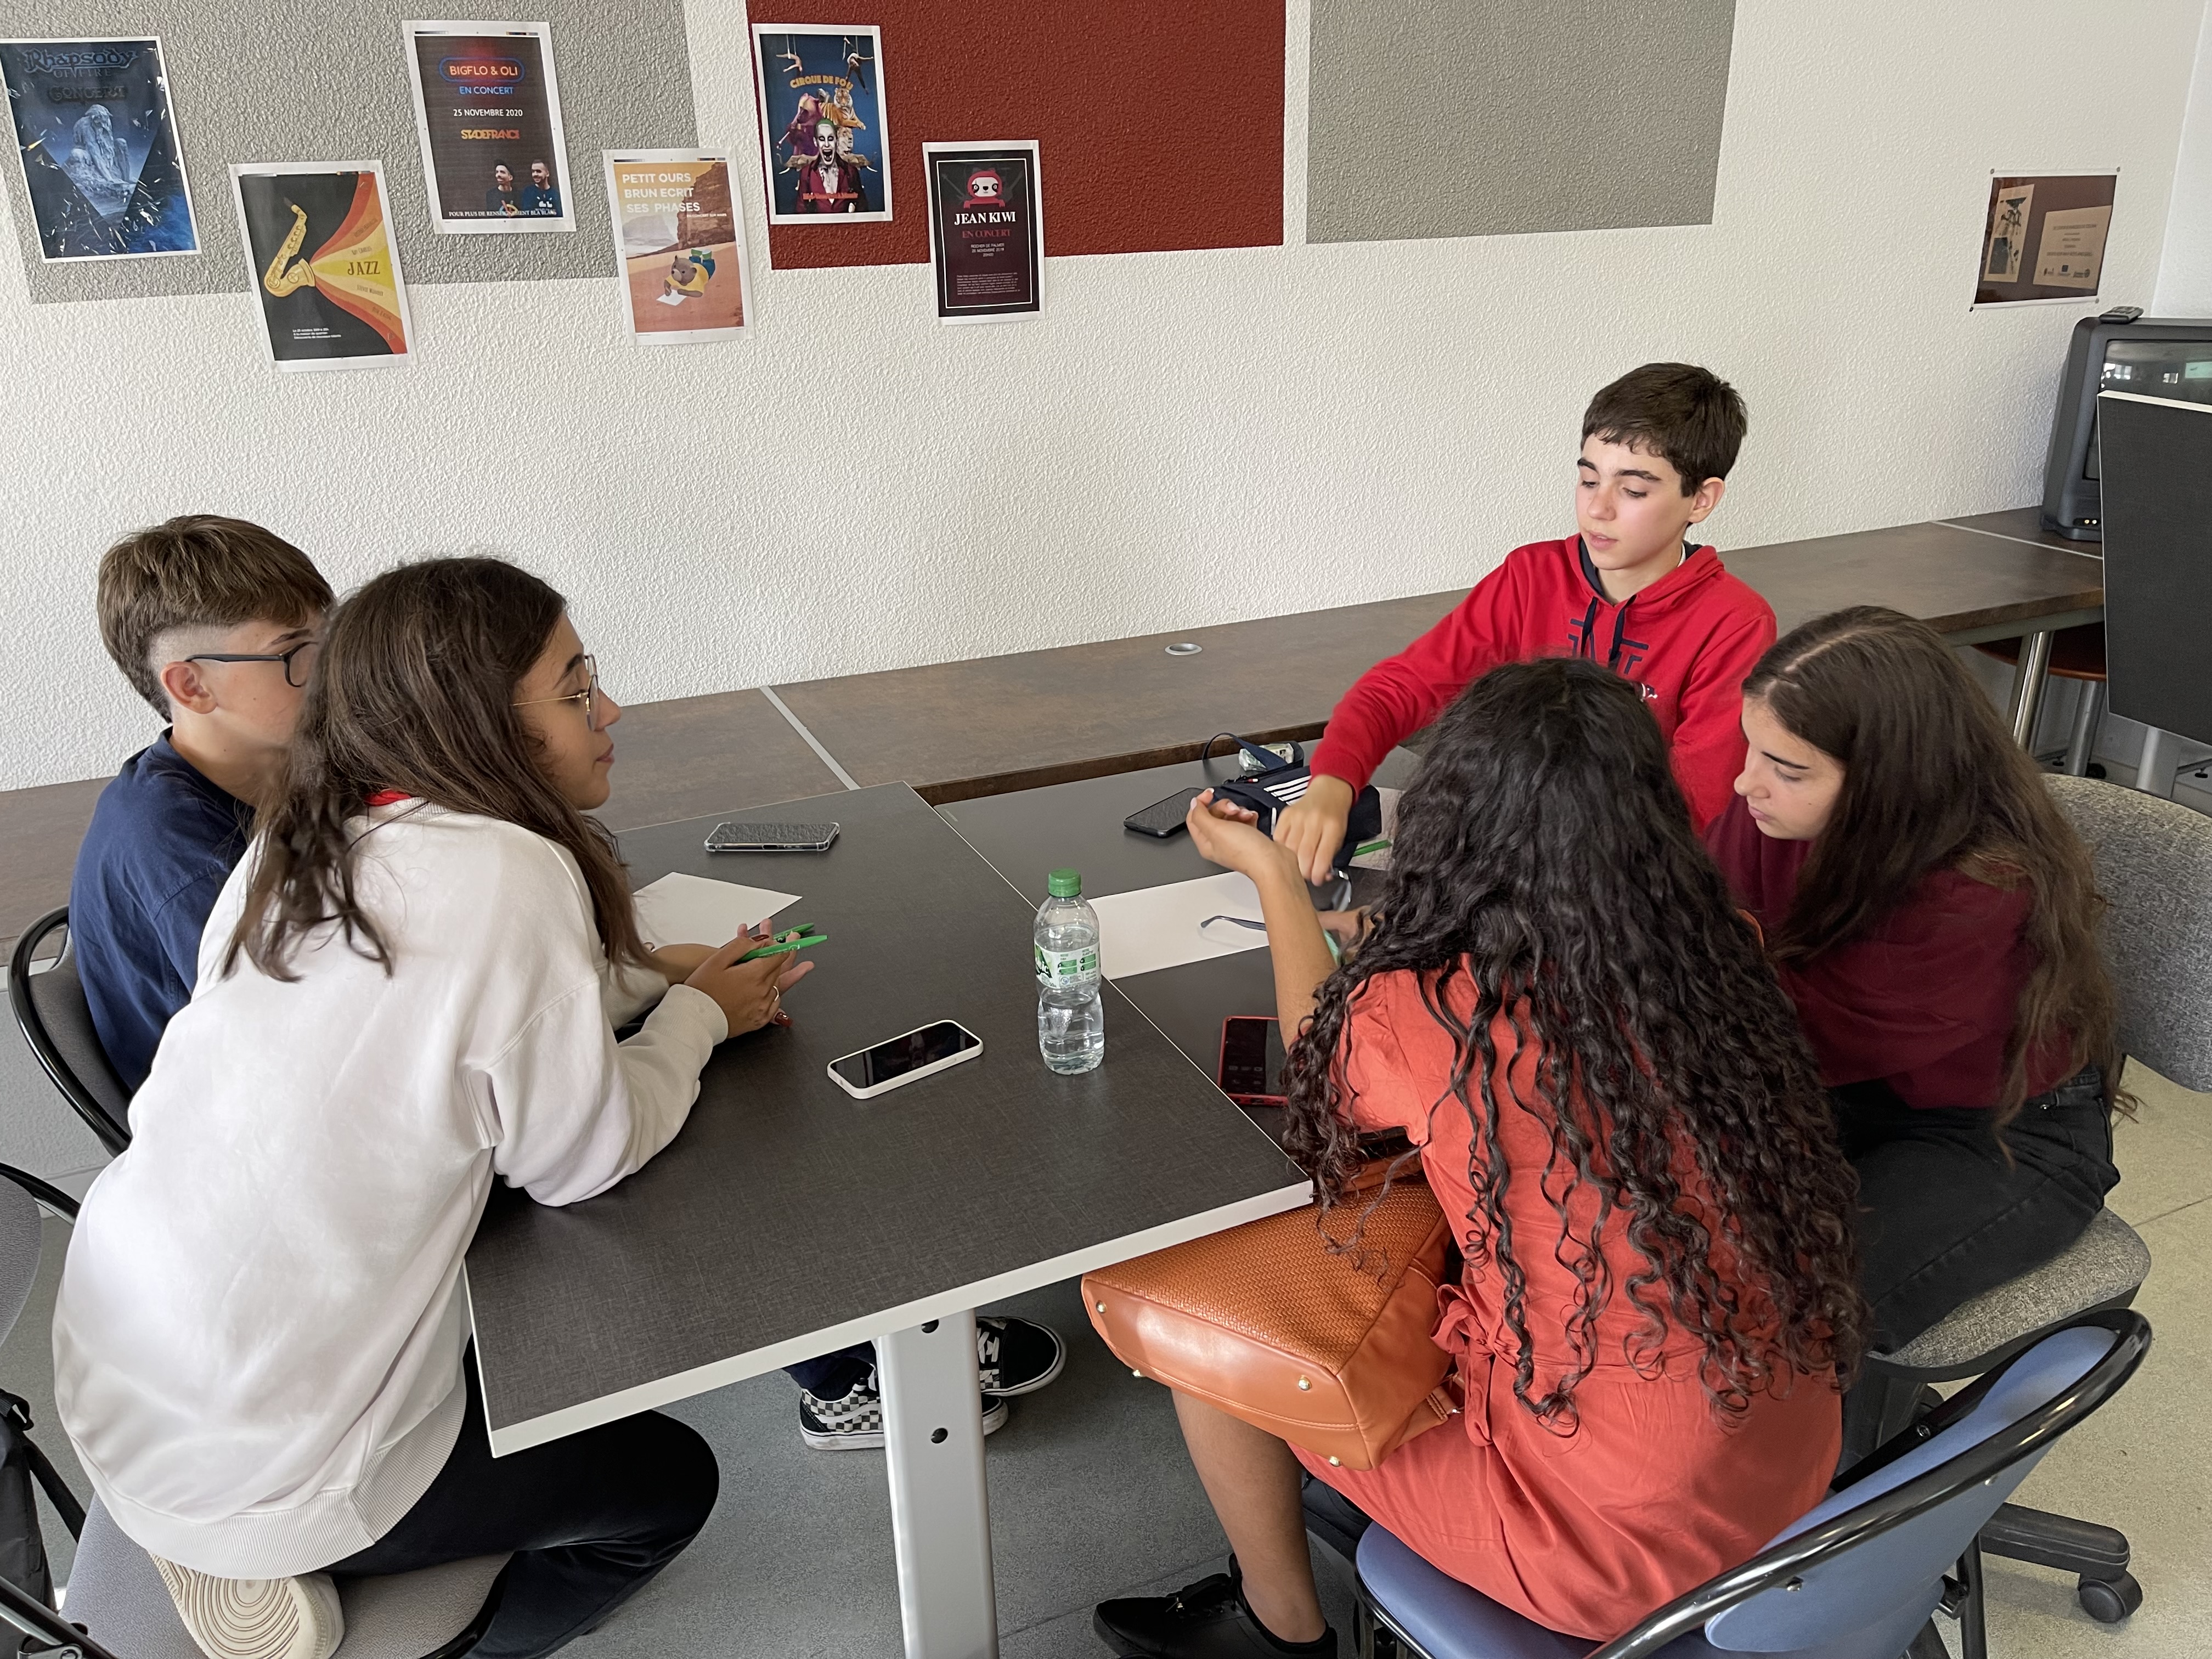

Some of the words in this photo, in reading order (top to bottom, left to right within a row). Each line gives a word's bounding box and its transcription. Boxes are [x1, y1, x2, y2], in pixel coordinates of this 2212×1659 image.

[449, 66, 488, 75] BIGFLO
[490, 66, 498, 75] &
[500, 66, 518, 76] OLI
[790, 75, 822, 88] CIRQUE
[822, 75, 833, 84] DE
[459, 86, 472, 94] EN
[473, 86, 514, 94] CONCERT
[622, 173, 656, 184] PETIT
[659, 173, 691, 183] OURS
[624, 189, 657, 199] BRUN
[661, 188, 694, 198] ECRIT
[627, 204, 649, 213] SES
[654, 202, 701, 213] PHASES
[954, 213, 986, 225] JEAN
[989, 211, 1016, 223] KIWI
[975, 229, 1011, 238] CONCERT
[347, 261, 381, 275] JAZZ
